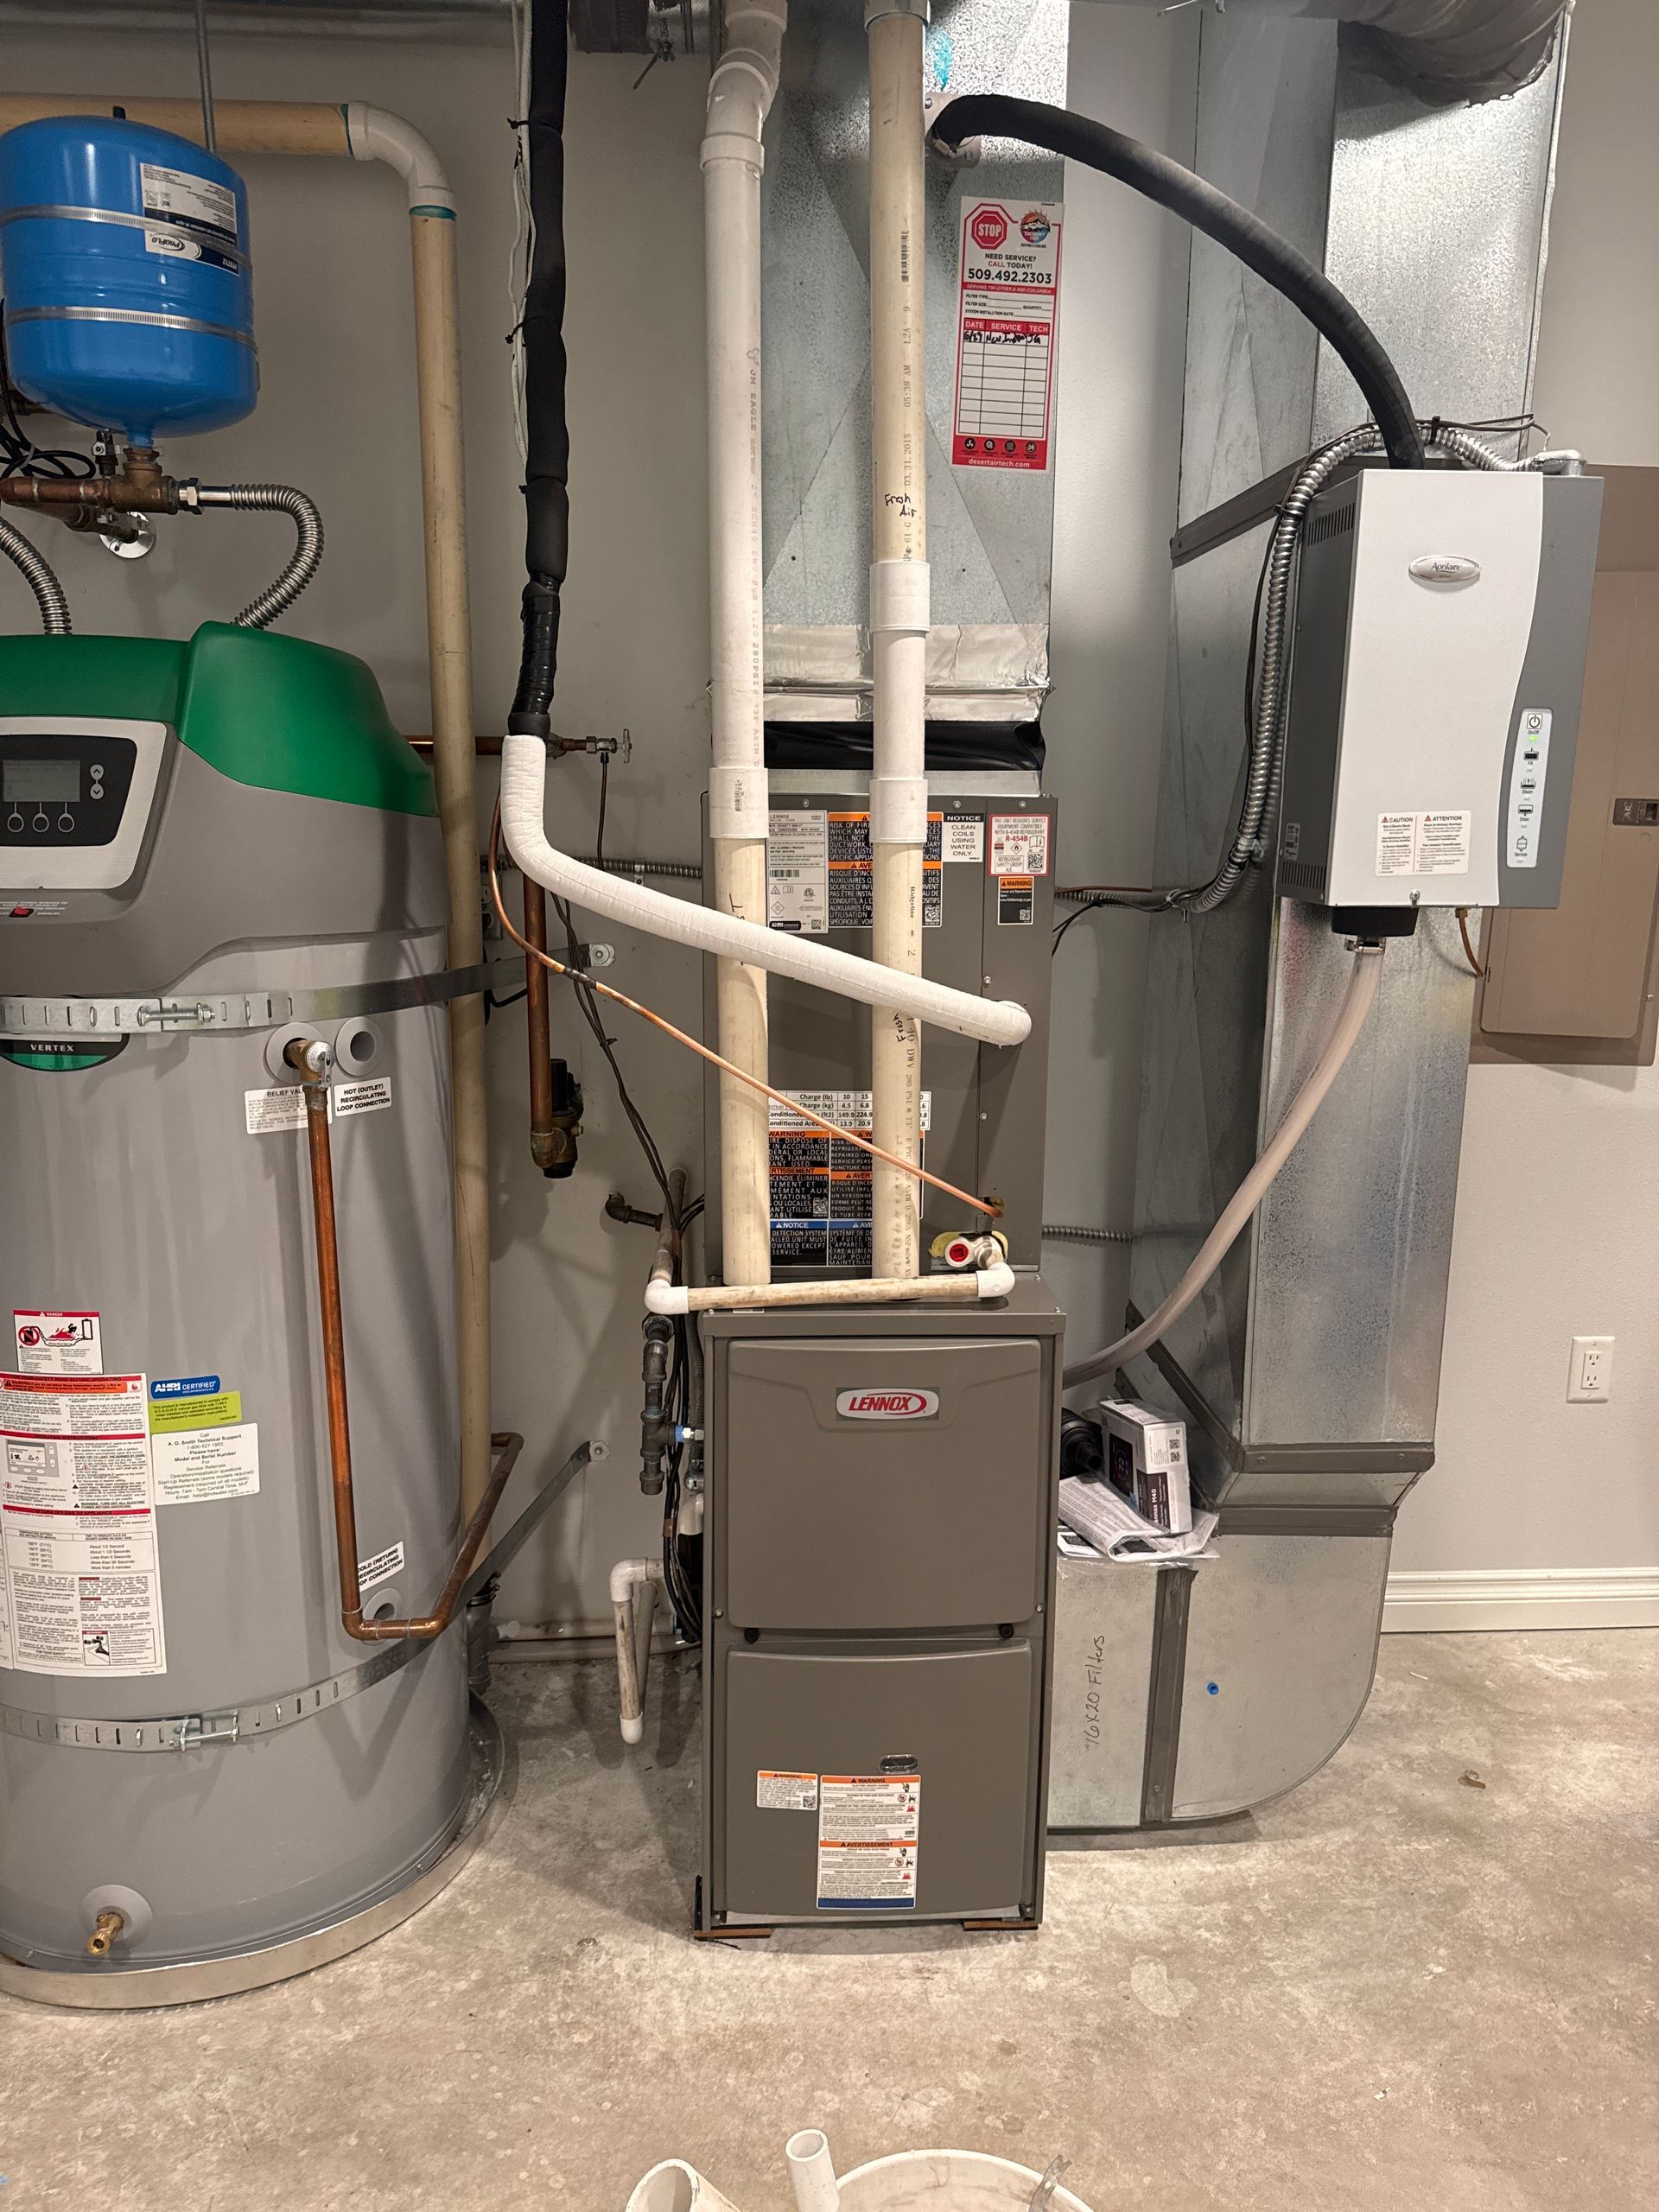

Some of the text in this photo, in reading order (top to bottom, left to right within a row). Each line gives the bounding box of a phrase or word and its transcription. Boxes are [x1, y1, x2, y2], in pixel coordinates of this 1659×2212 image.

[978, 223, 1002, 237] STOP
[151, 238, 181, 248] PROFLO
[968, 268, 1052, 284] 509.492.2303
[991, 322, 1022, 331] SERVICE
[968, 458, 1030, 468] desertairtech.com
[1432, 562, 1461, 572] Aprilaire
[906, 1049, 915, 1069] DWV
[358, 1084, 384, 1094] (OUTLET)
[340, 1090, 386, 1103] RECIRCULATING
[337, 1098, 391, 1112] LOOP CONNECTION
[155, 1382, 181, 1393] AHRI
[182, 1381, 215, 1390] CERTIFIED
[849, 1396, 912, 1411] LENNOX
[369, 1559, 403, 1581] CONNECTION
[1084, 1635, 1105, 1685] Filters
